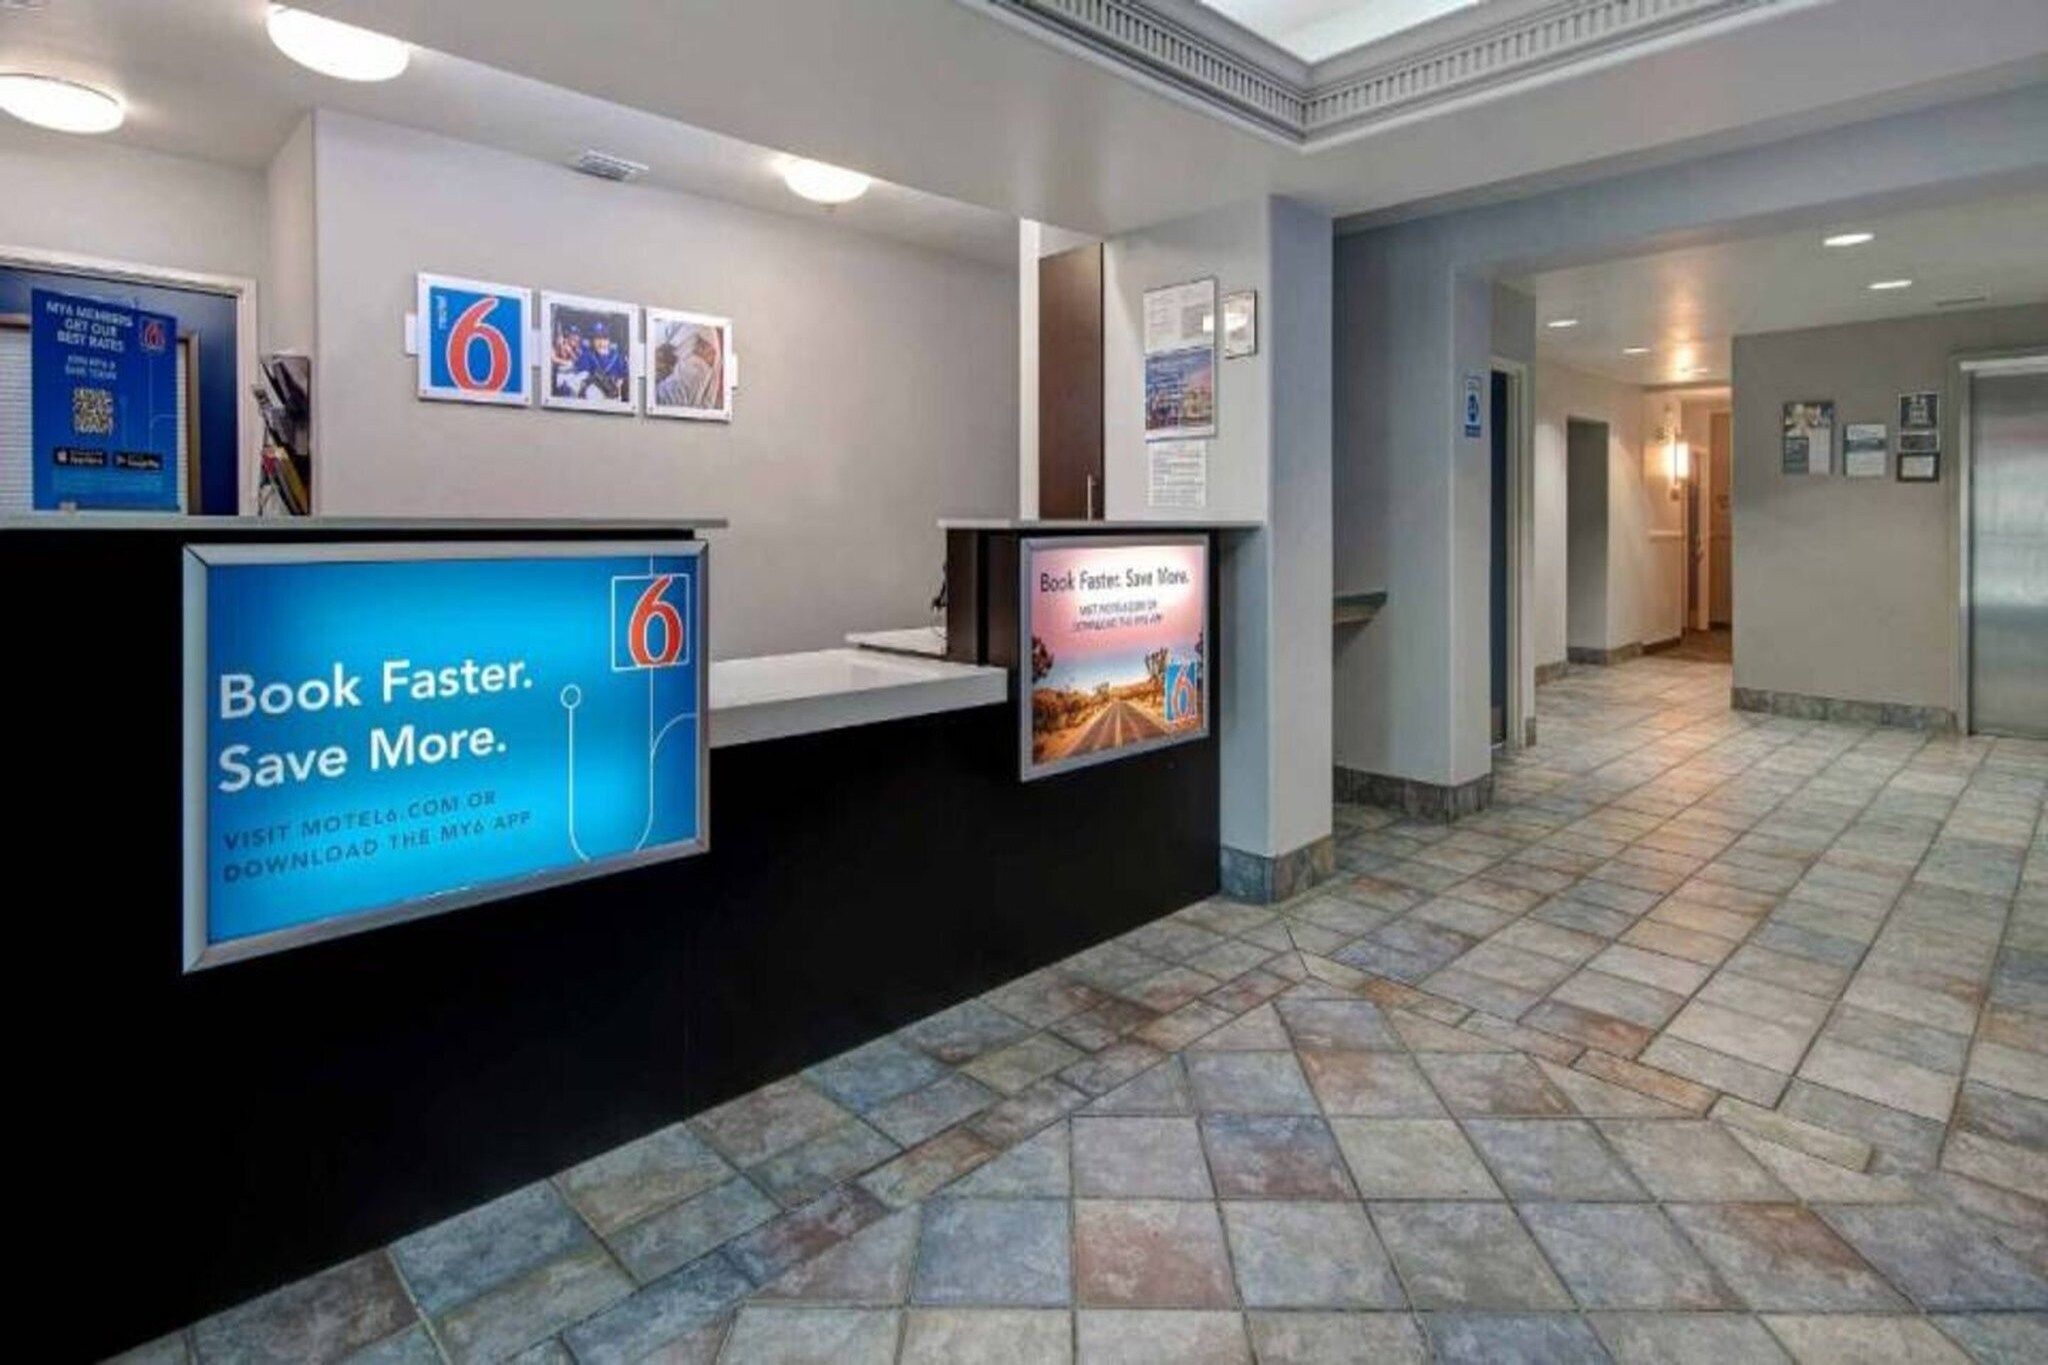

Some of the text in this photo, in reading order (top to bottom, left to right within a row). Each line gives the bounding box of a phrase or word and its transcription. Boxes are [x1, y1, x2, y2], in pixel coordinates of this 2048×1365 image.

[57, 329, 125, 353] BEST RATES
[446, 296, 512, 394] 6
[1040, 566, 1190, 593] Book Faster. Save More.
[628, 576, 685, 668] 6
[220, 659, 533, 720] Book Faster.
[218, 724, 507, 793] Save More.
[222, 824, 292, 851] VISIT
[466, 790, 497, 808] OR
[222, 811, 533, 884] DOWNLOAD THE MY6 APP
